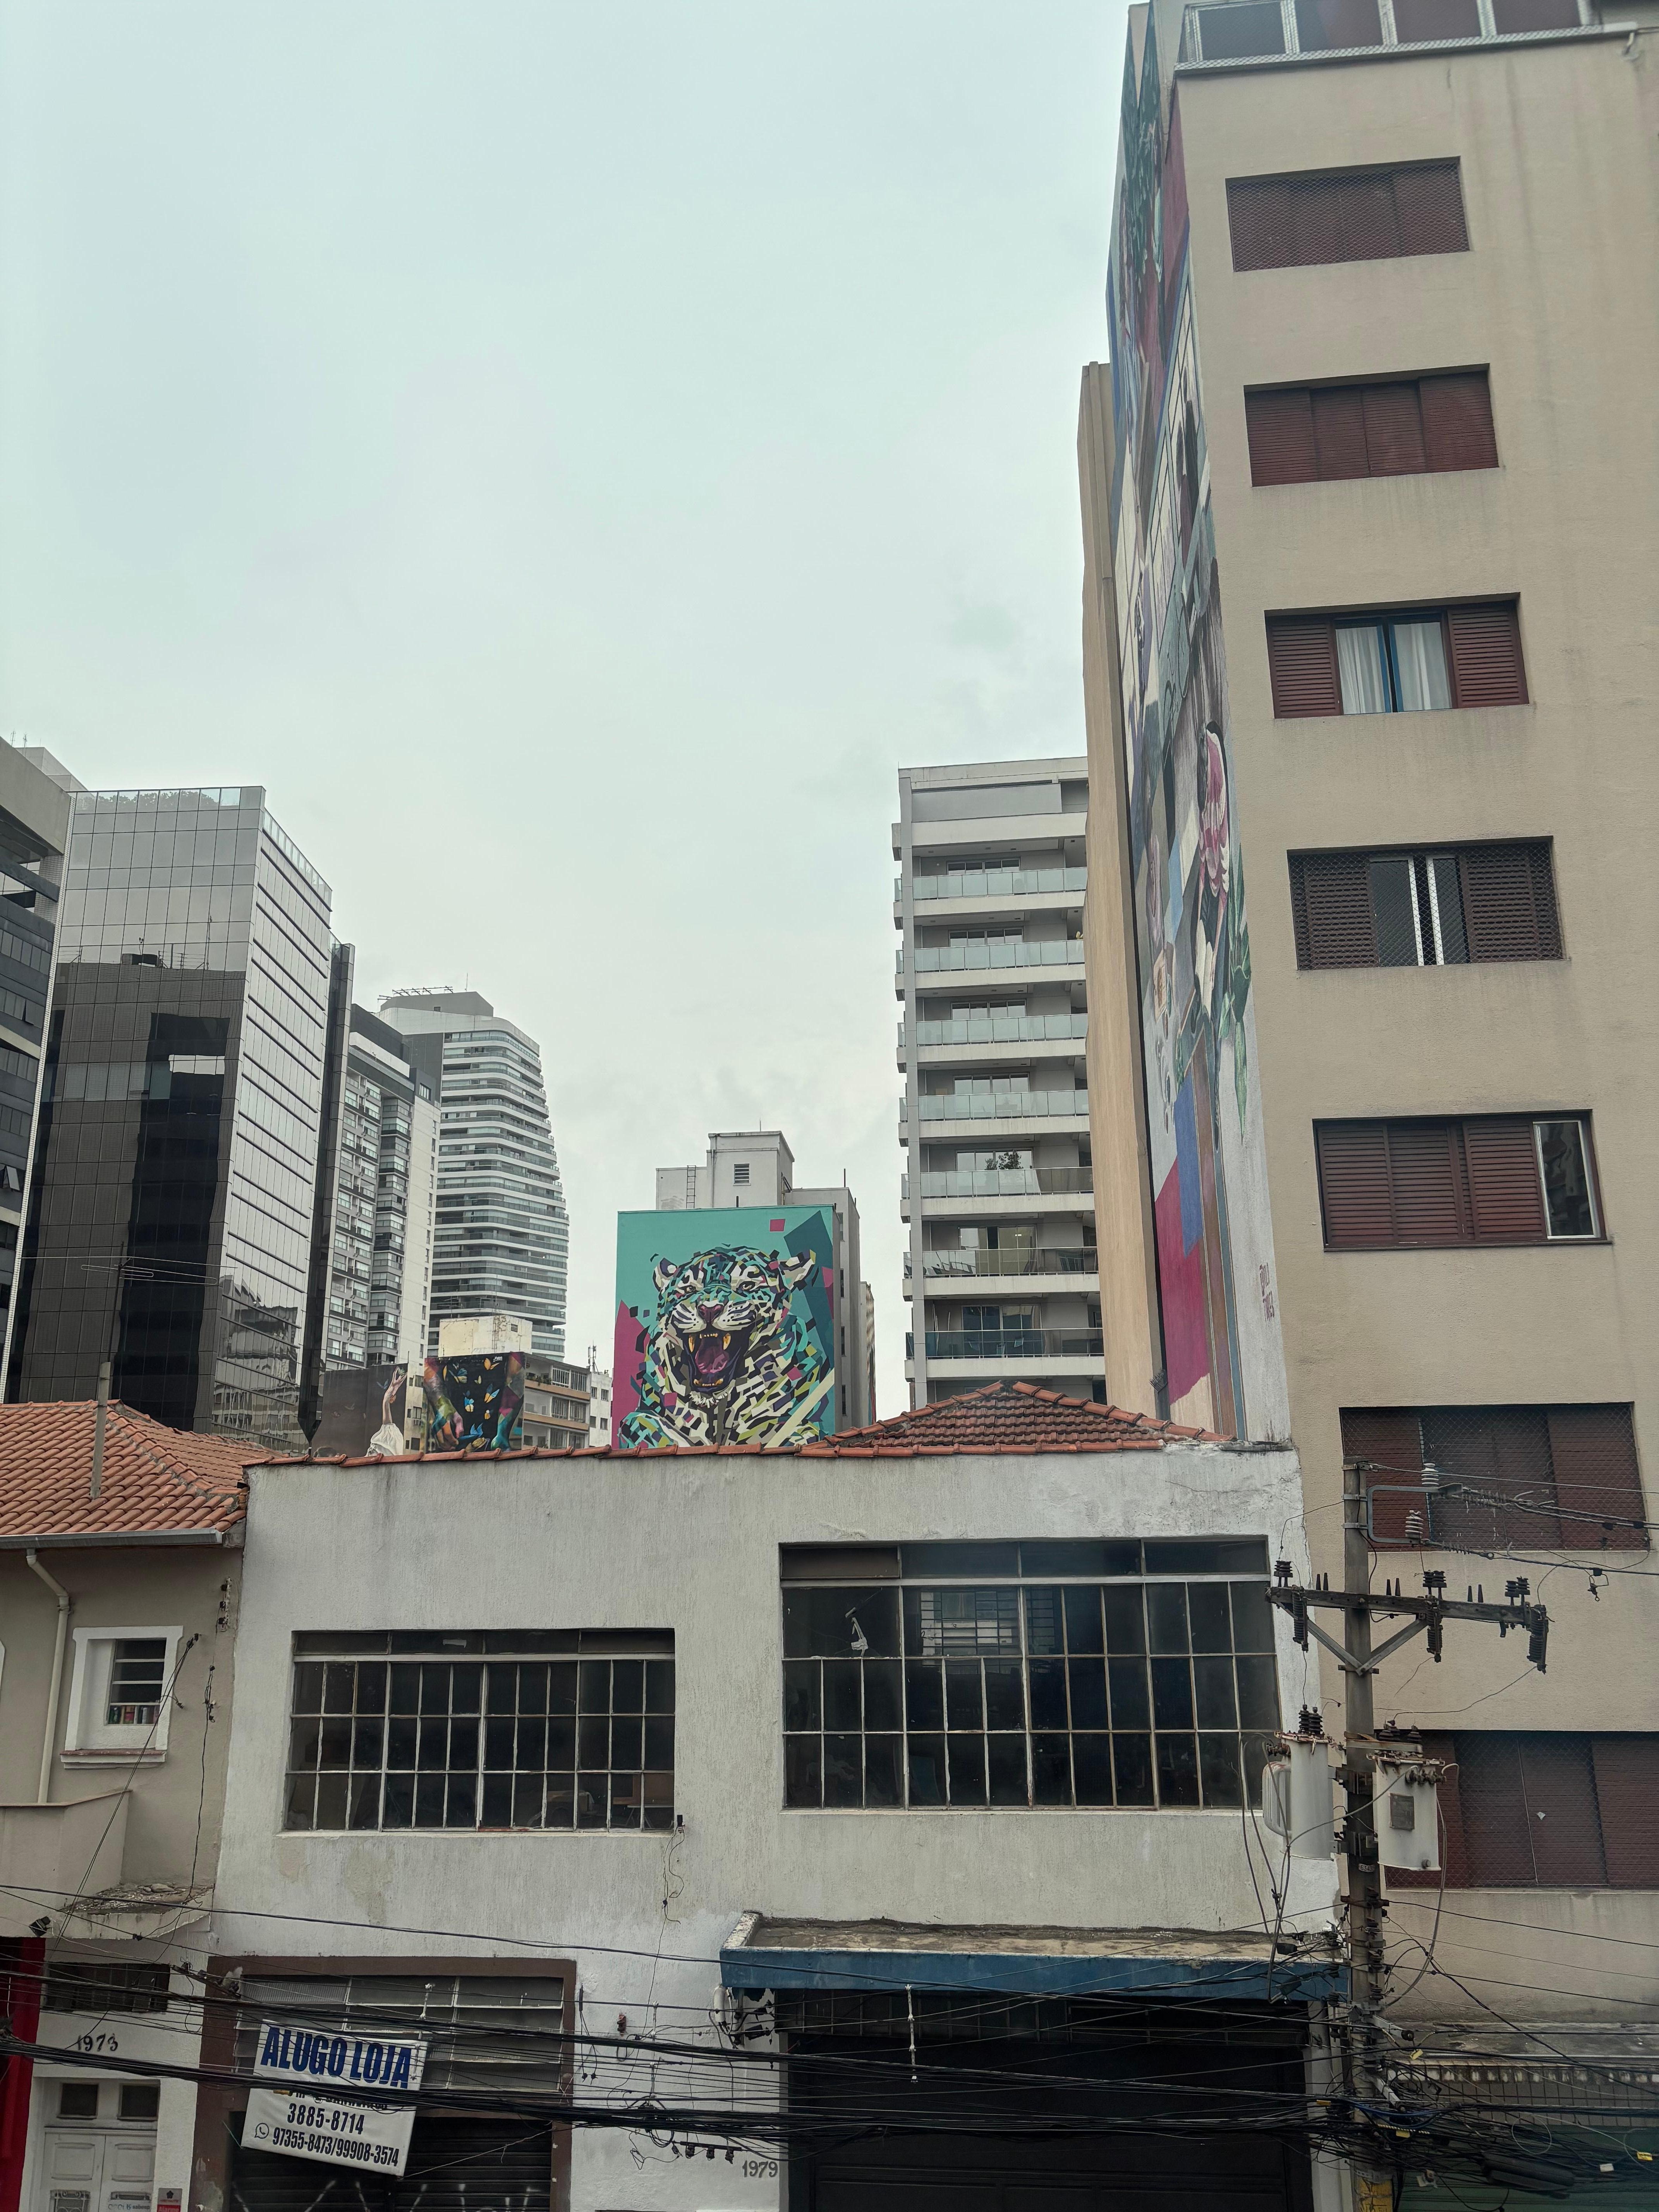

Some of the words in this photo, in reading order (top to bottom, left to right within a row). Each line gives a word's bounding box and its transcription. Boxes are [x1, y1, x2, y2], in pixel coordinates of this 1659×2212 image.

[261, 2027, 347, 2077] ALUGO
[350, 2040, 412, 2089] LOJA
[287, 2103, 364, 2135] 3885-8714
[273, 2127, 399, 2166] 97355-8473/99908-3574
[742, 2160, 778, 2178] 1979
